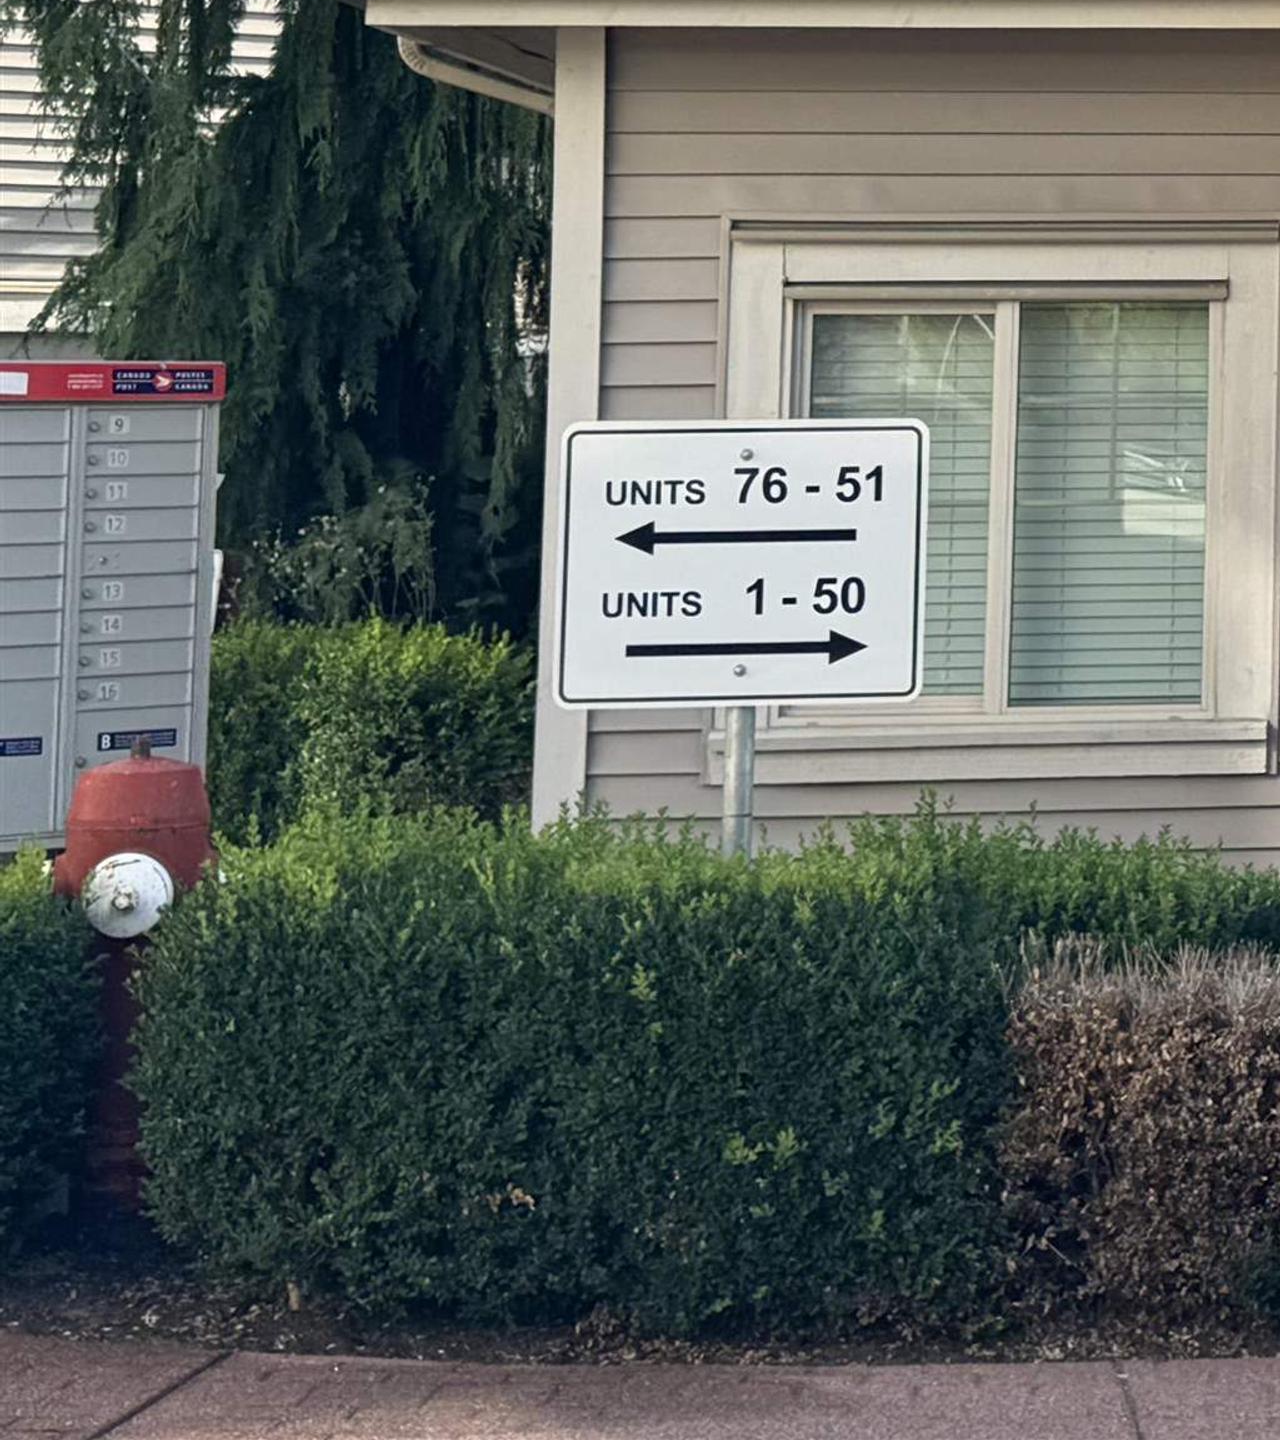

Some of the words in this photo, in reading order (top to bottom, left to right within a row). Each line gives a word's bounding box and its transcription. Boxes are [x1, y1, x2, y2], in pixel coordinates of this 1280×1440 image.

[114, 418, 124, 432] 9
[110, 451, 127, 466] 10
[605, 479, 706, 506] UNITS
[733, 466, 788, 504] 76
[805, 485, 820, 494] -
[835, 464, 884, 503] 51
[106, 517, 124, 532] 12
[104, 584, 121, 599] 13
[601, 591, 703, 618] UNITS
[745, 578, 766, 615] 1
[781, 596, 798, 606] -
[812, 576, 867, 615] 50
[103, 617, 120, 632] 14
[102, 651, 119, 665] 15
[101, 734, 111, 749] B
